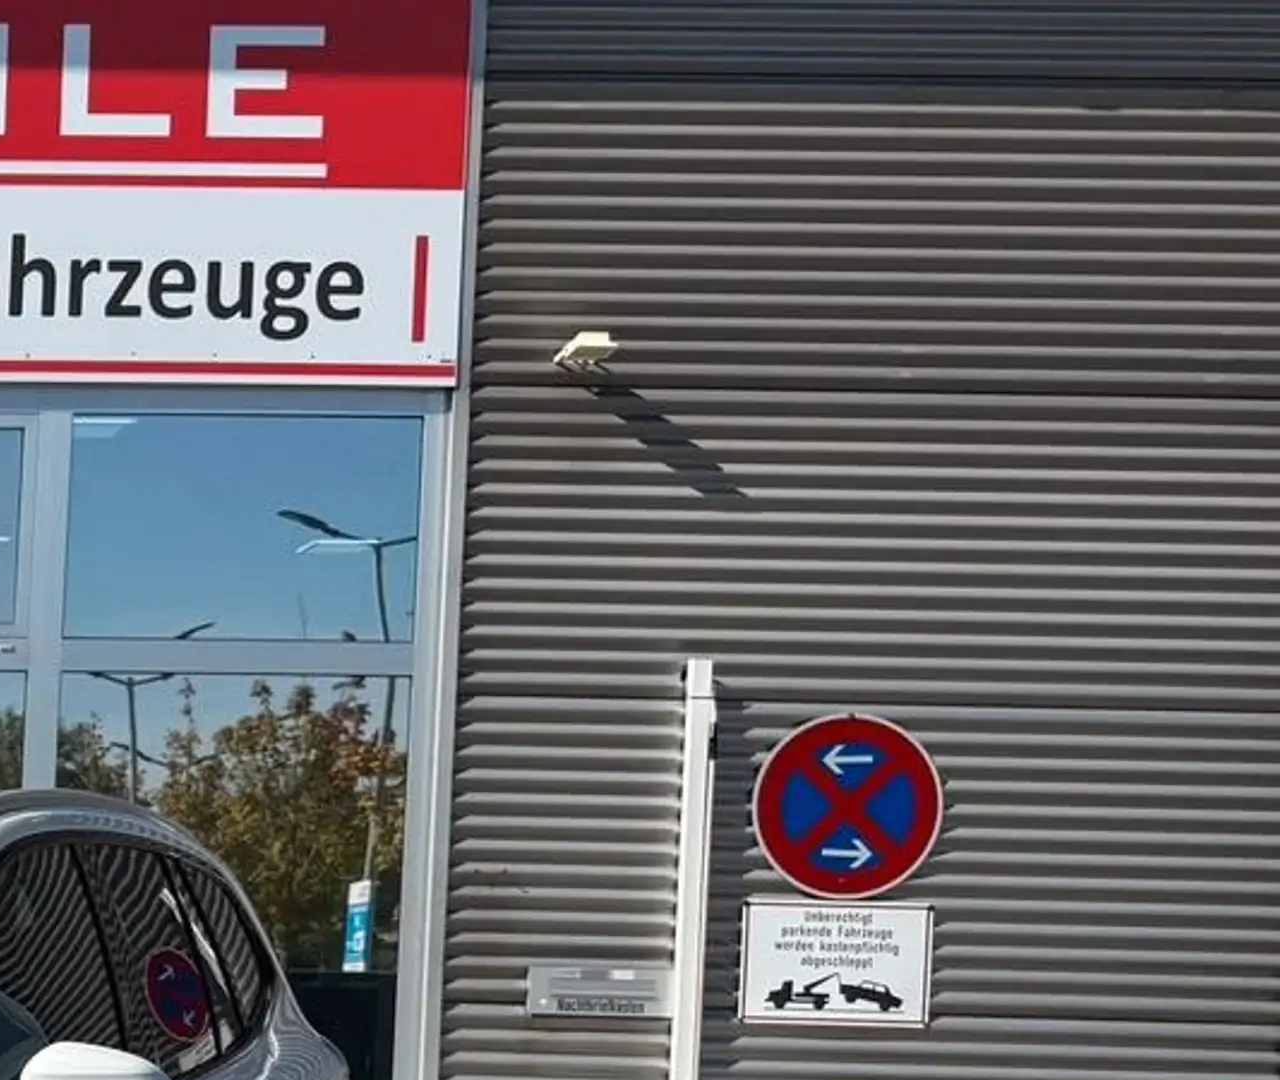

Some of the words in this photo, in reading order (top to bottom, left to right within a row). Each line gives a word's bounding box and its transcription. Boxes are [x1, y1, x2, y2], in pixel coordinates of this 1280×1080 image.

[803, 910, 874, 926] Unberechtigt
[780, 925, 833, 938] parkende
[837, 925, 894, 941] Fahrzeuge
[774, 940, 814, 951] werden
[799, 955, 874, 970] abgeschleppt
